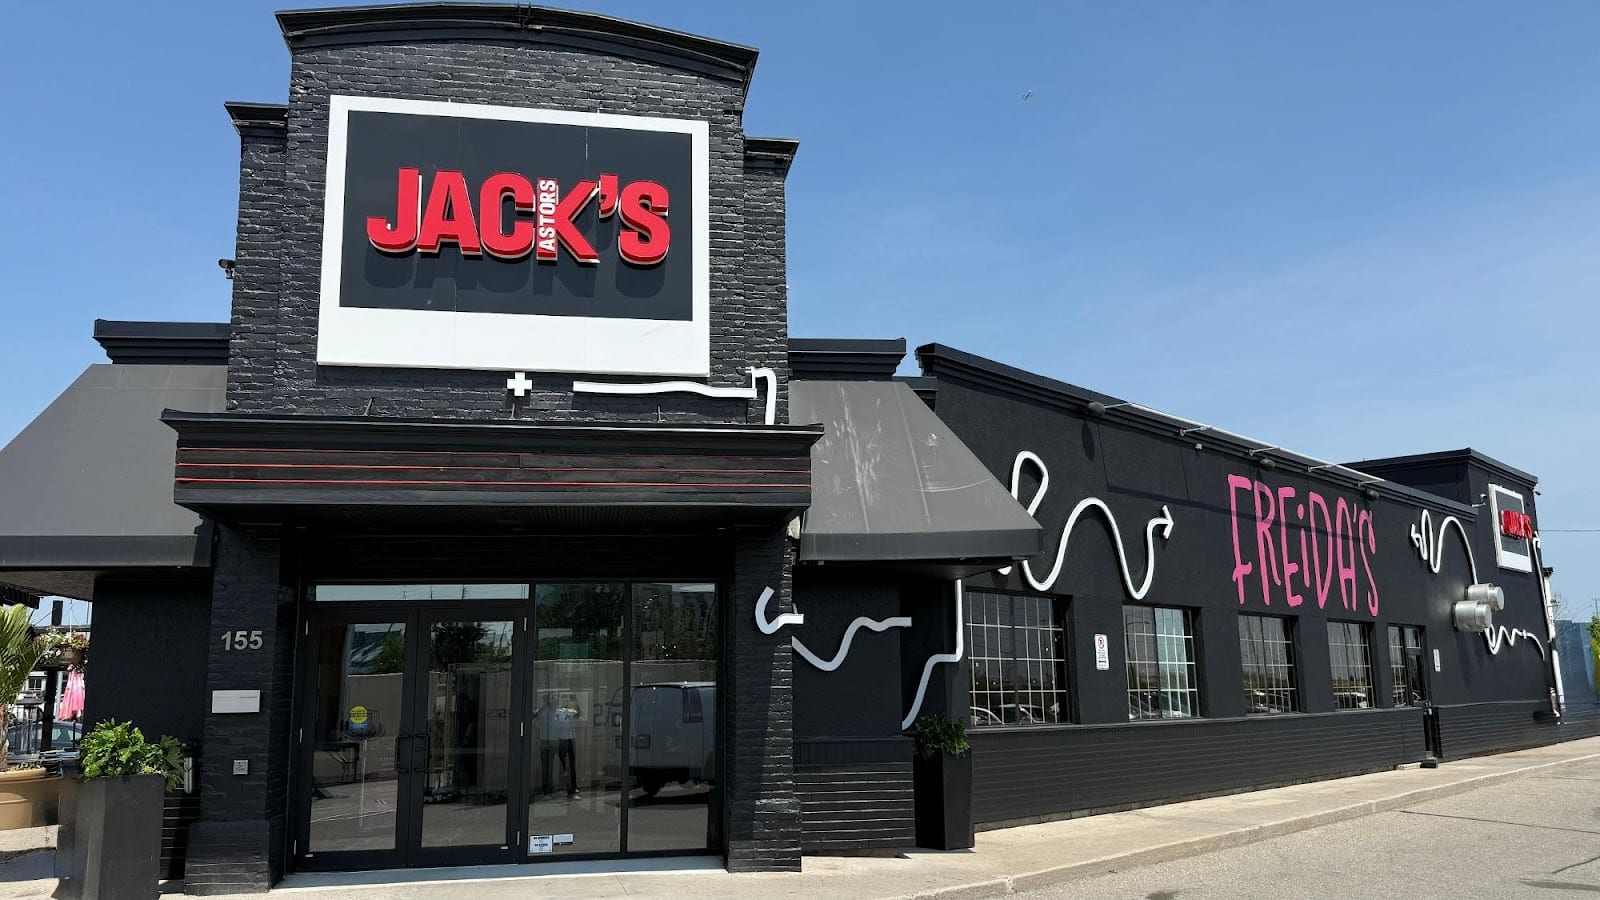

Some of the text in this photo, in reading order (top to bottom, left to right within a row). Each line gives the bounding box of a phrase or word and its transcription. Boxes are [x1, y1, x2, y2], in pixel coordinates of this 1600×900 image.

[366, 167, 671, 264] JACK'S
[540, 179, 557, 252] ASTORS
[221, 630, 263, 651] 155
